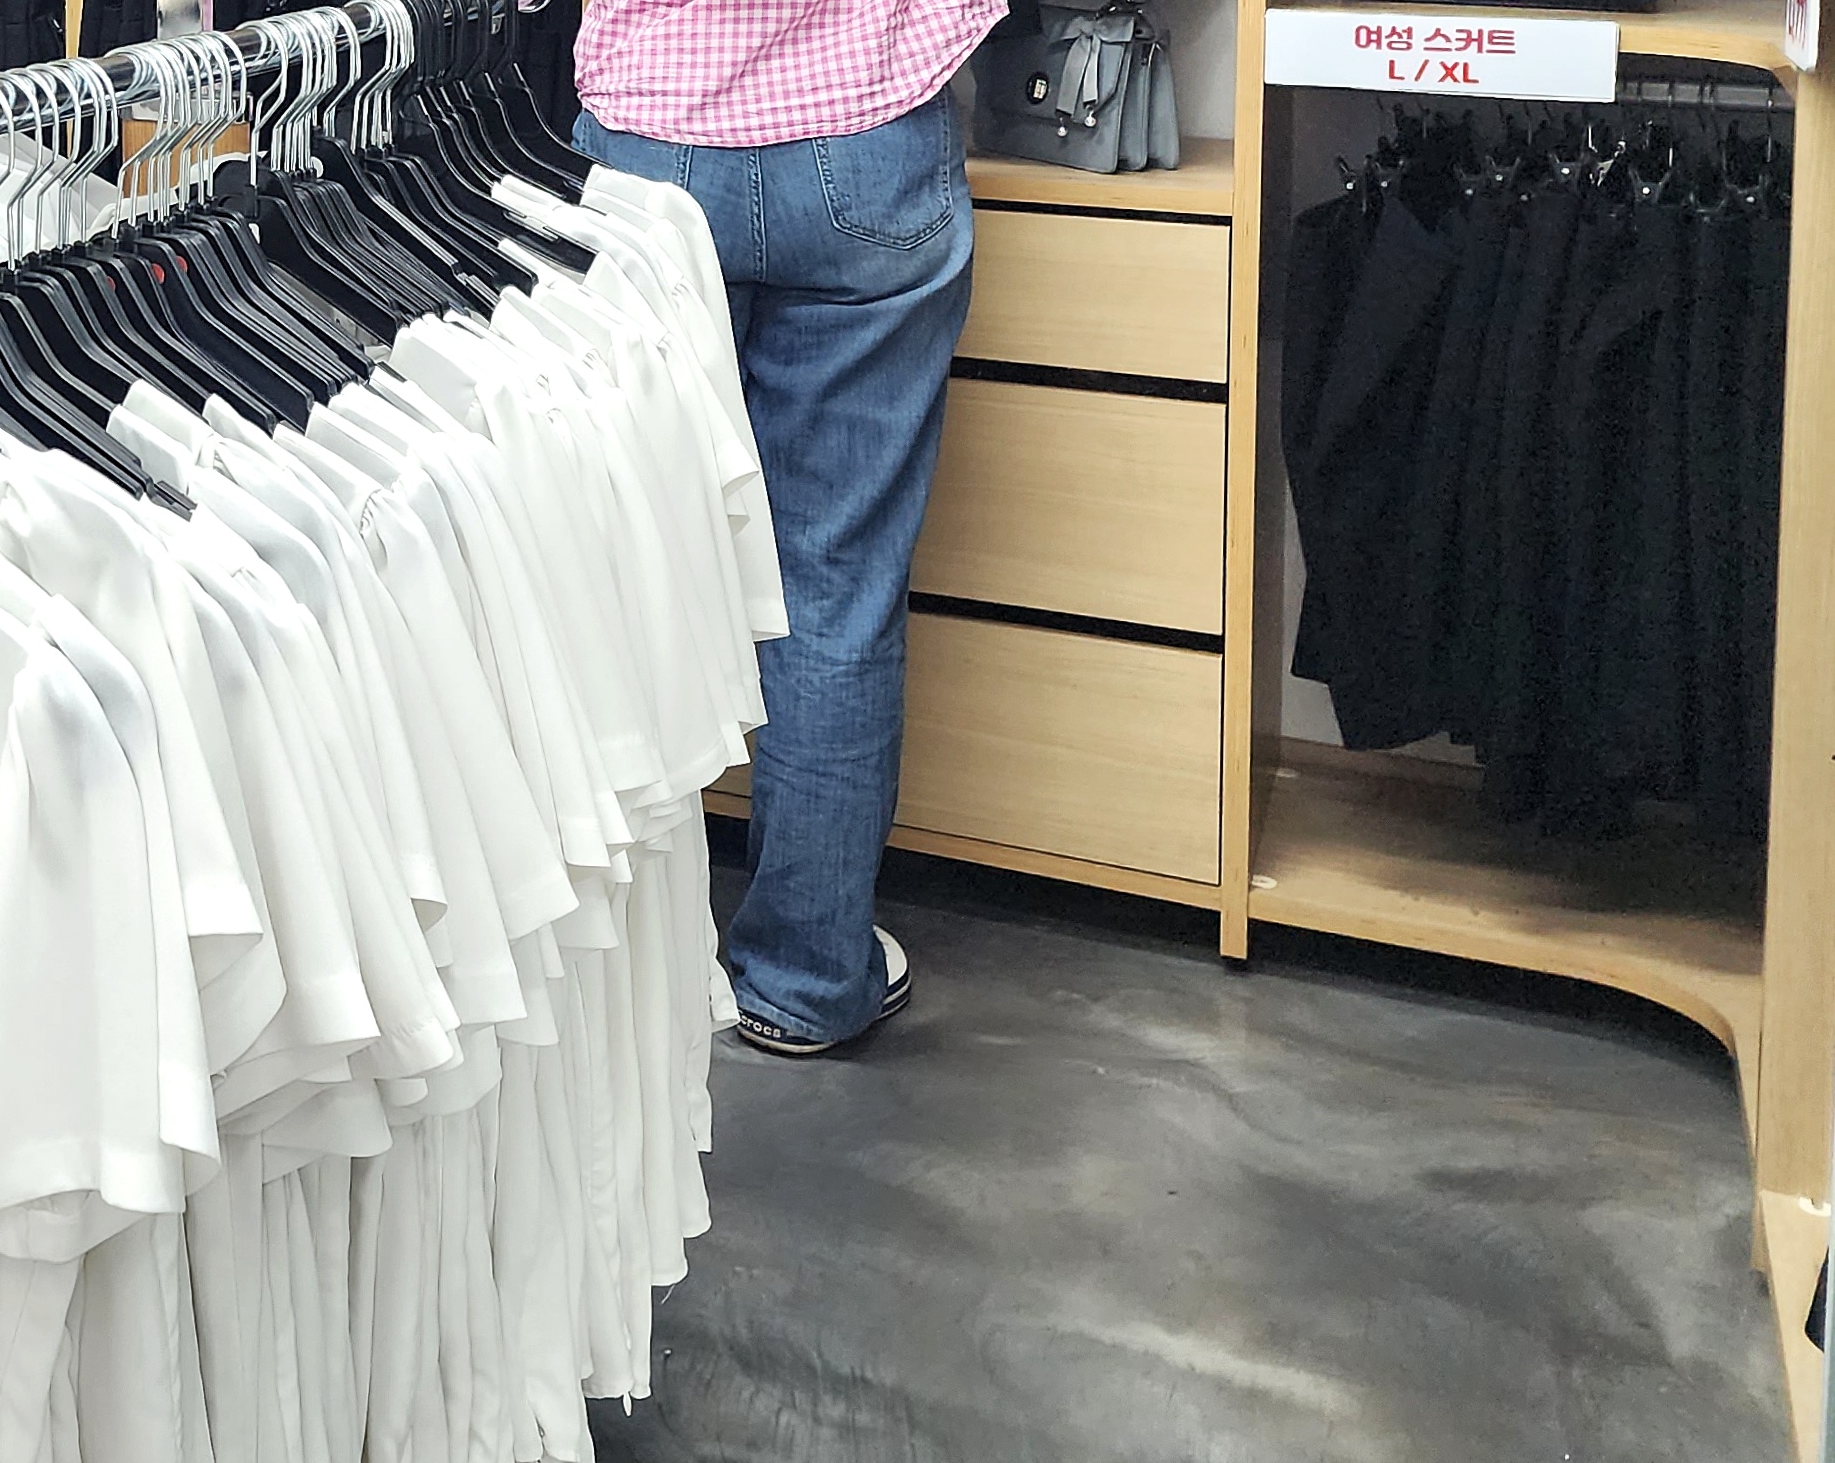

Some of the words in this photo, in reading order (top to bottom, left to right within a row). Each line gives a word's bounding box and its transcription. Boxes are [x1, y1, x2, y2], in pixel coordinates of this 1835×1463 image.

[1354, 25, 1414, 51] 여성
[1423, 28, 1517, 54] 스커트
[1388, 60, 1406, 80] L
[1414, 59, 1430, 82] /
[1438, 61, 1480, 84] XL
